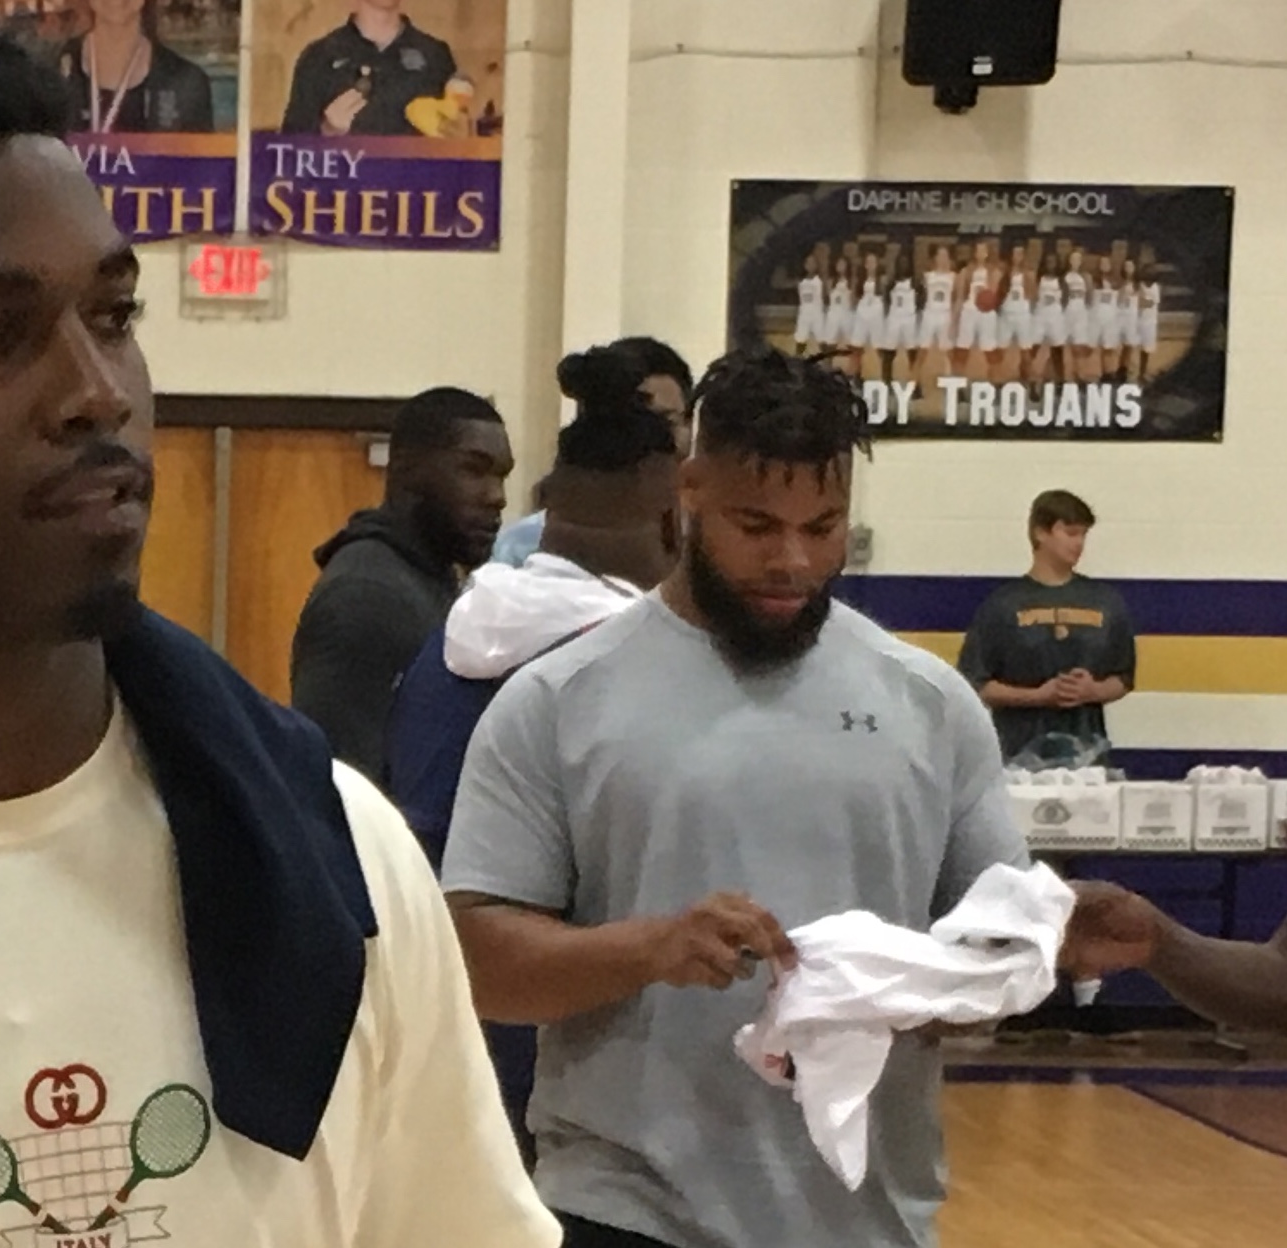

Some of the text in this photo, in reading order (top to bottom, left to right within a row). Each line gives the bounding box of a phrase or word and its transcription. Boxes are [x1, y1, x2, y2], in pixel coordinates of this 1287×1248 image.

[266, 143, 366, 179] TREY
[265, 181, 484, 238] SHEILS
[847, 189, 1115, 216] DAPHNE HIGH SCHOOL
[200, 244, 263, 294] EXIT
[863, 376, 1143, 428] DY TROJANS
